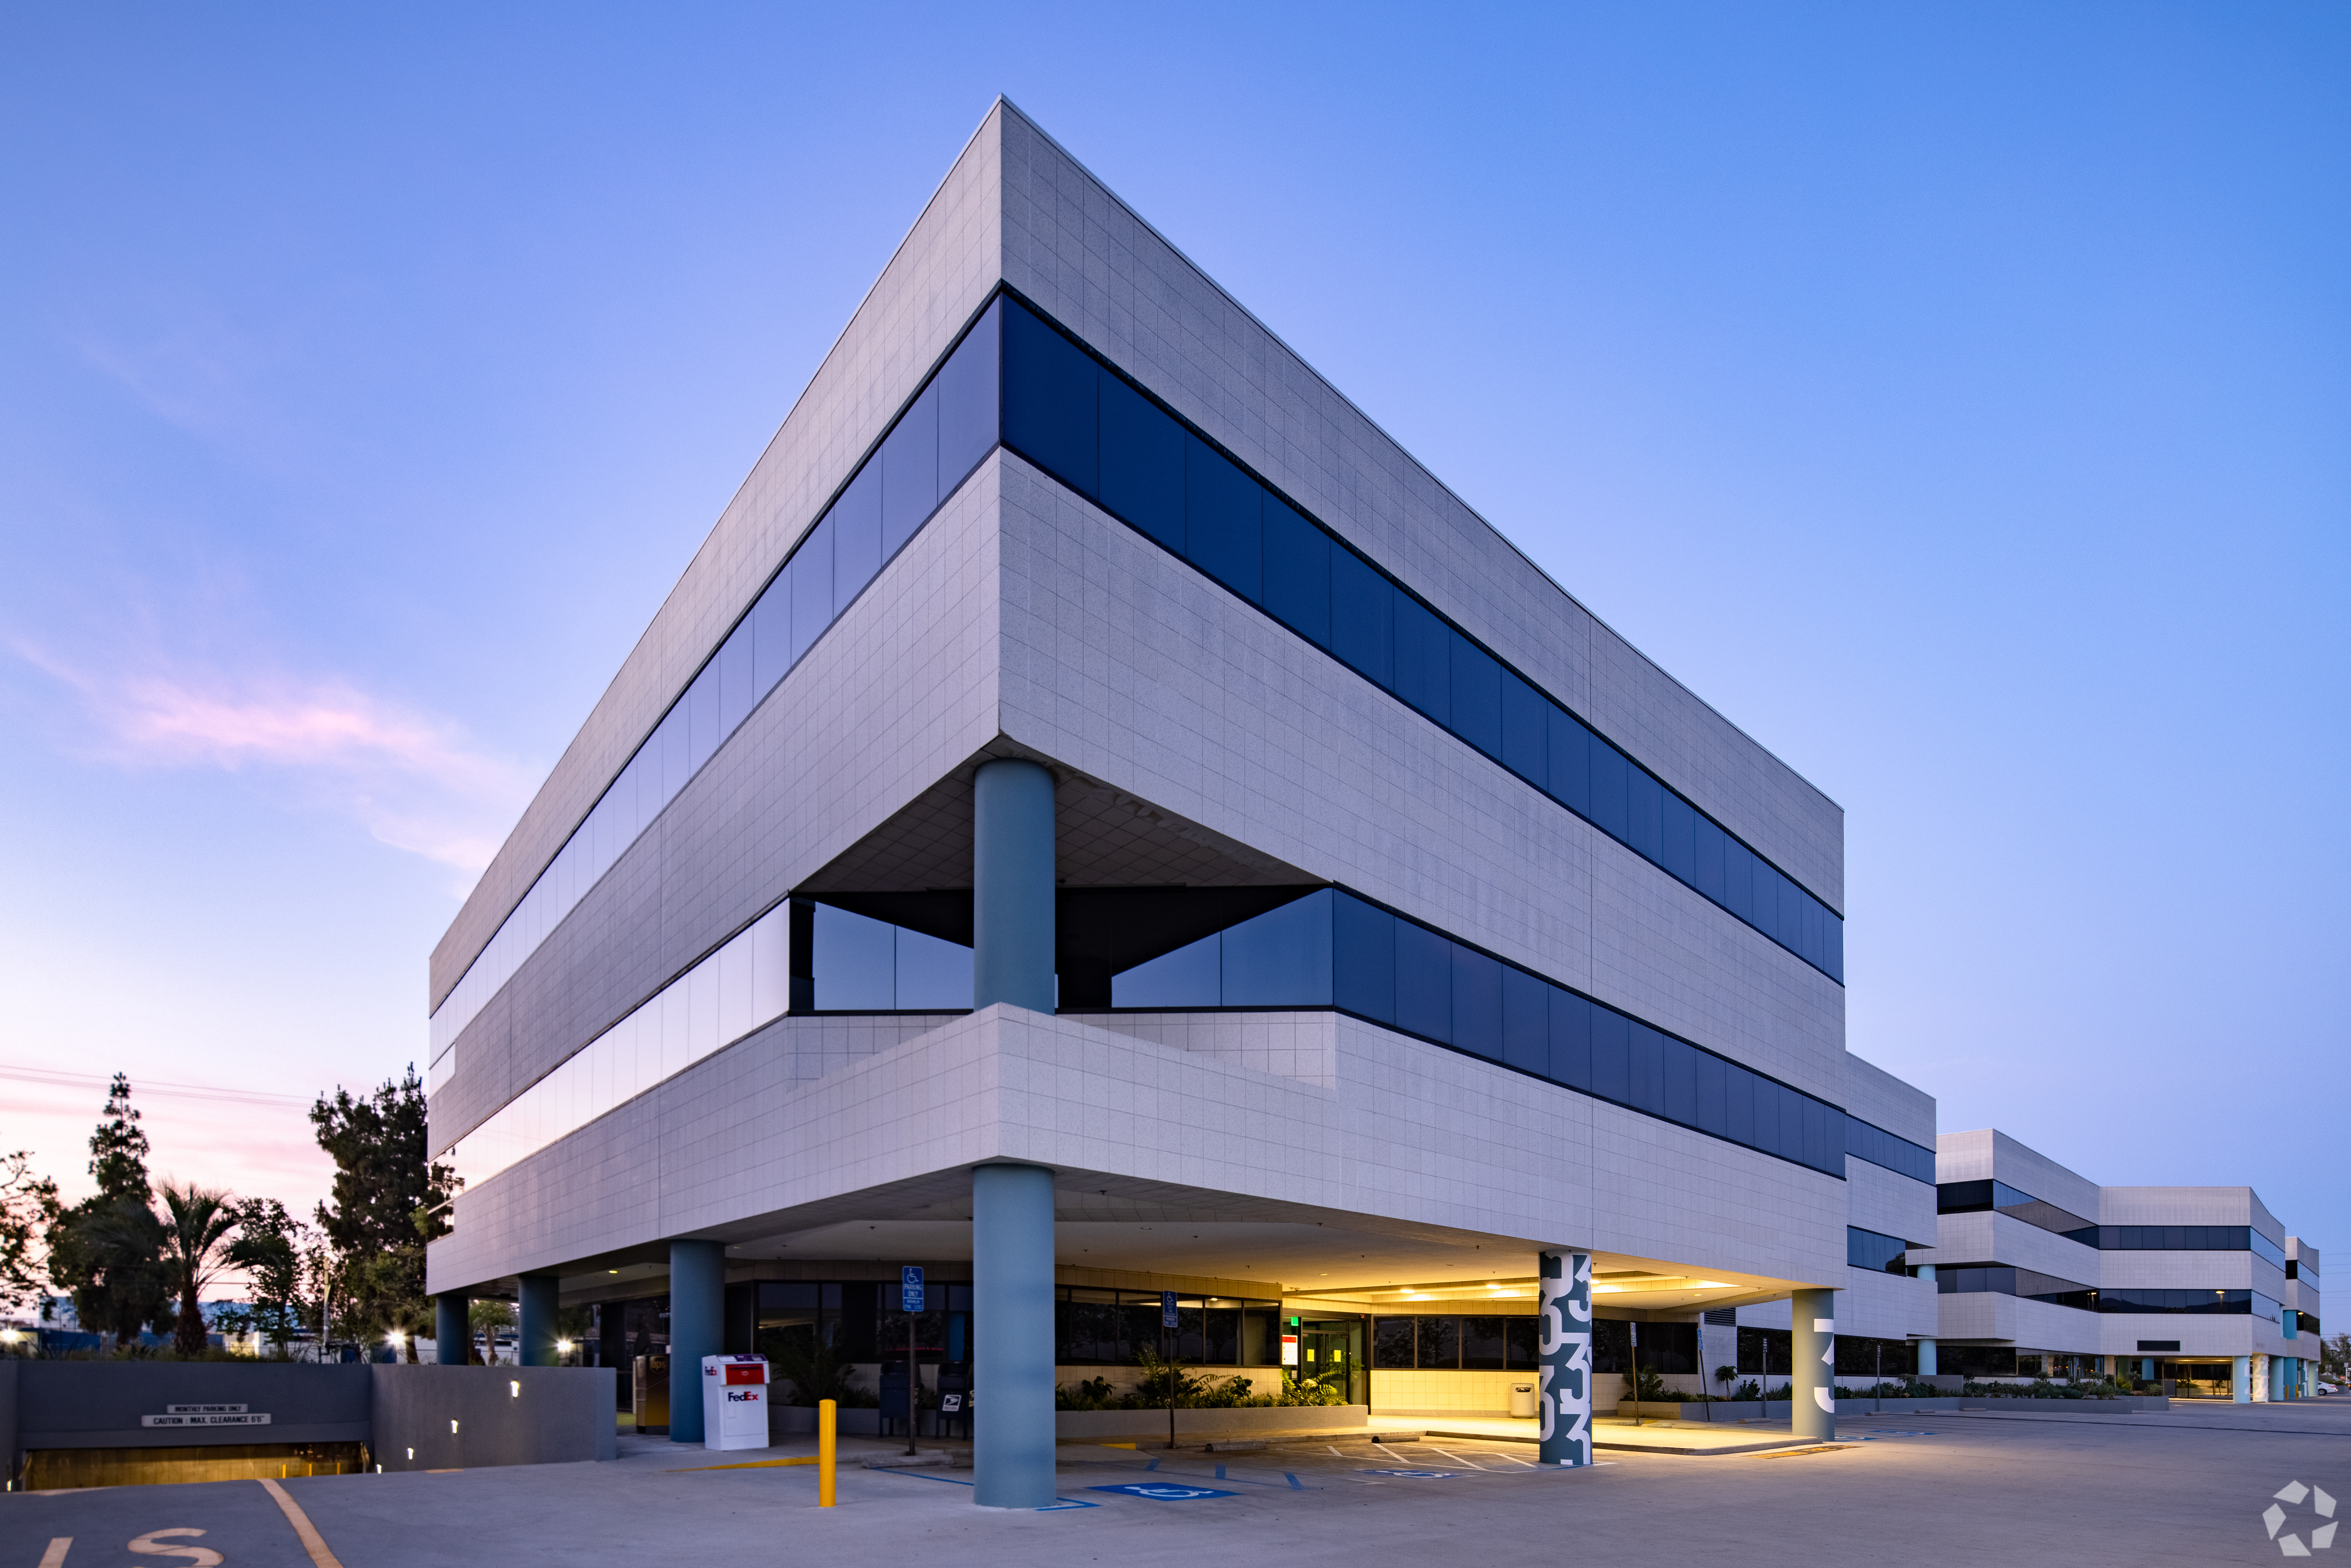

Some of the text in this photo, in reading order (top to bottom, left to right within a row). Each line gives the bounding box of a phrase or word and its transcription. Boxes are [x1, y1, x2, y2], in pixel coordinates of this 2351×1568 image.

[651, 1360, 665, 1371] ups
[705, 1366, 717, 1376] FedEx
[728, 1391, 758, 1402] FedEx
